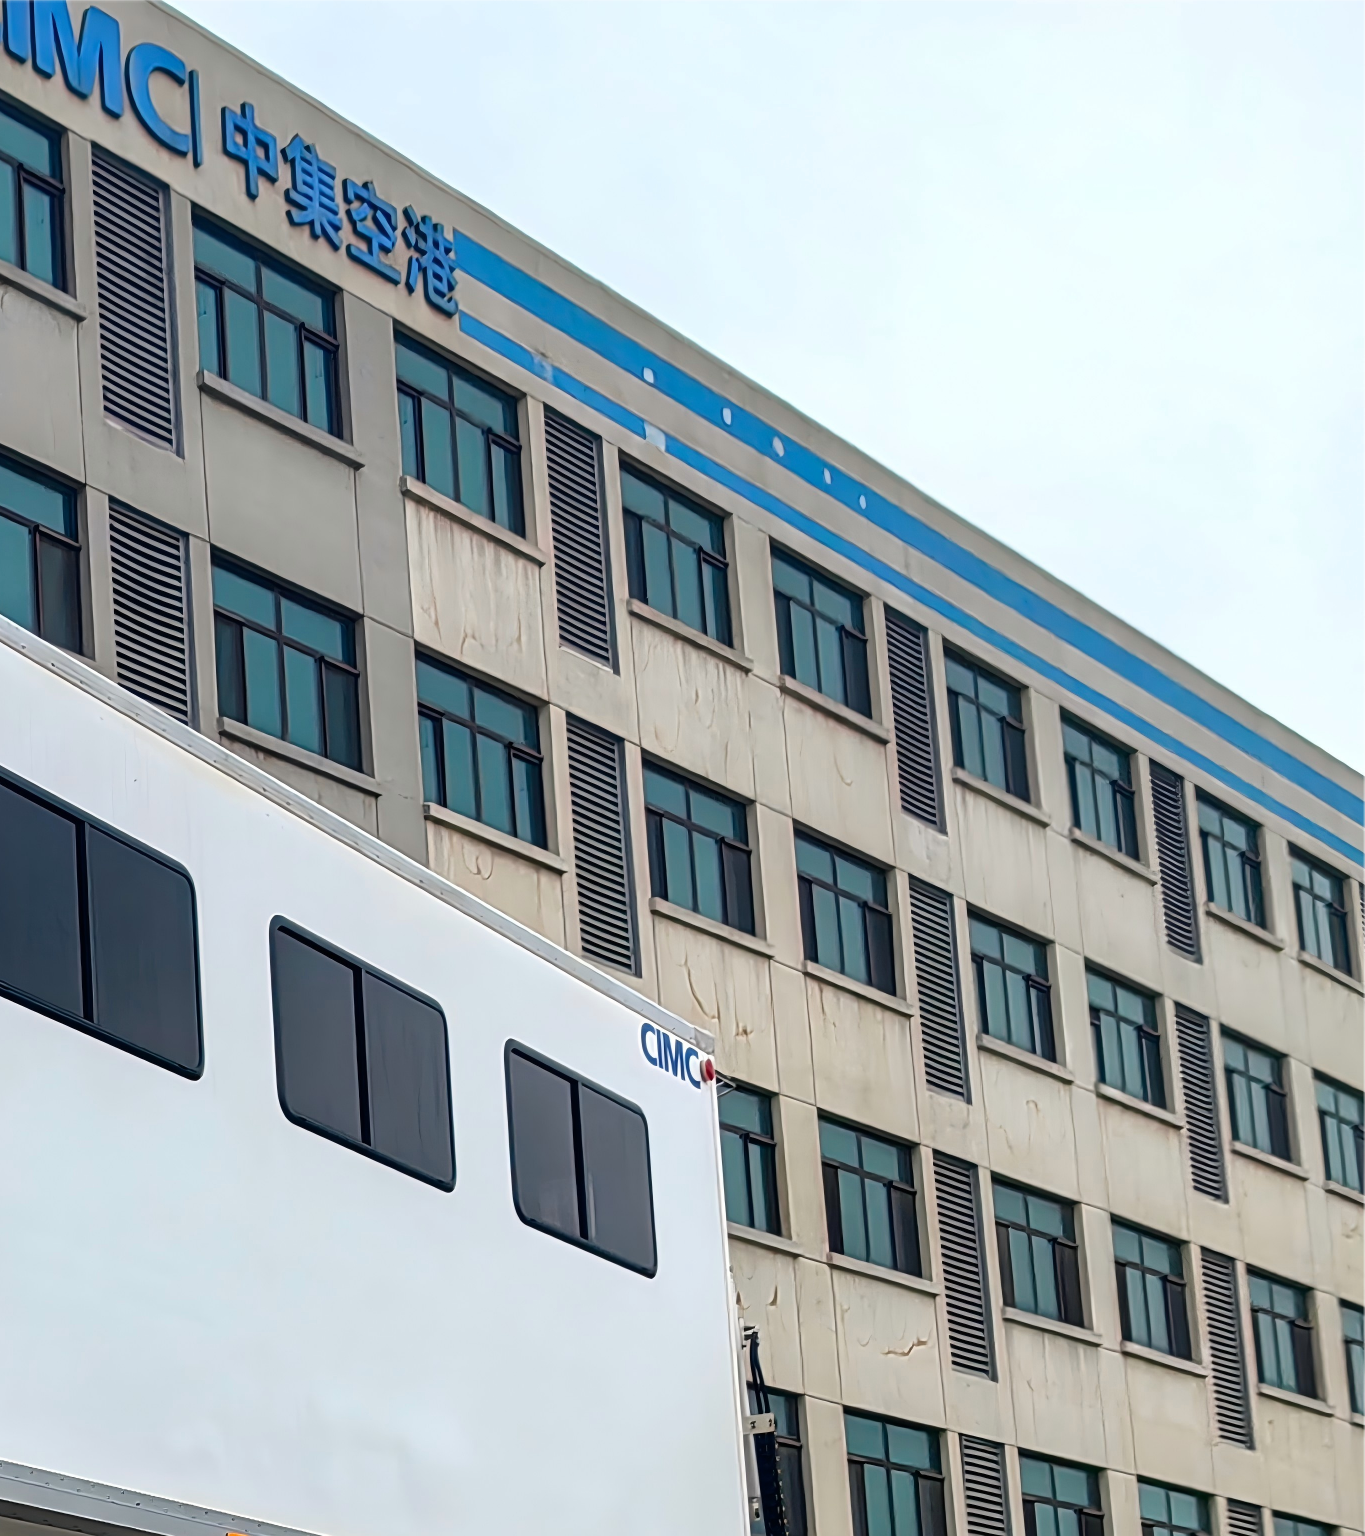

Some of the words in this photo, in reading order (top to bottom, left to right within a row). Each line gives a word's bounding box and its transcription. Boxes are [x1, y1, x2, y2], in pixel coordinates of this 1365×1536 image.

[221, 101, 458, 318] 中集空港
[640, 1022, 701, 1090] CIMC
